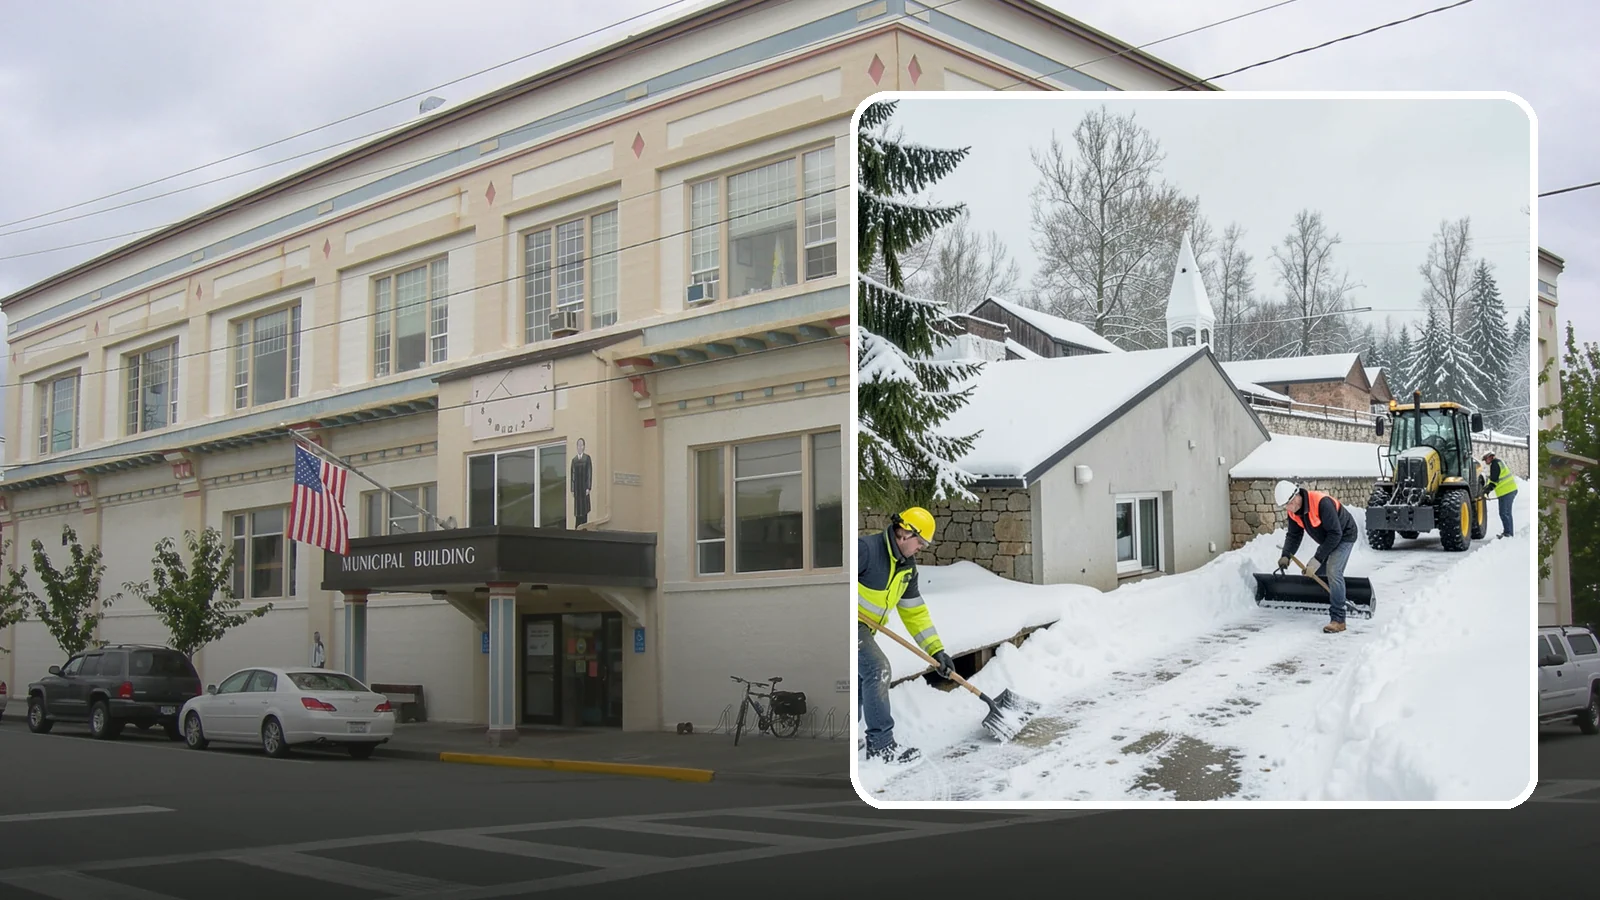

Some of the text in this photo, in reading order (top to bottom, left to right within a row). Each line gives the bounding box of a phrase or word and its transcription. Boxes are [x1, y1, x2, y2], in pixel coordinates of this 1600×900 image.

[494, 423, 500, 432] 10
[507, 425, 513, 433] 12
[341, 546, 476, 572] MUNICIPAL BUILDING
